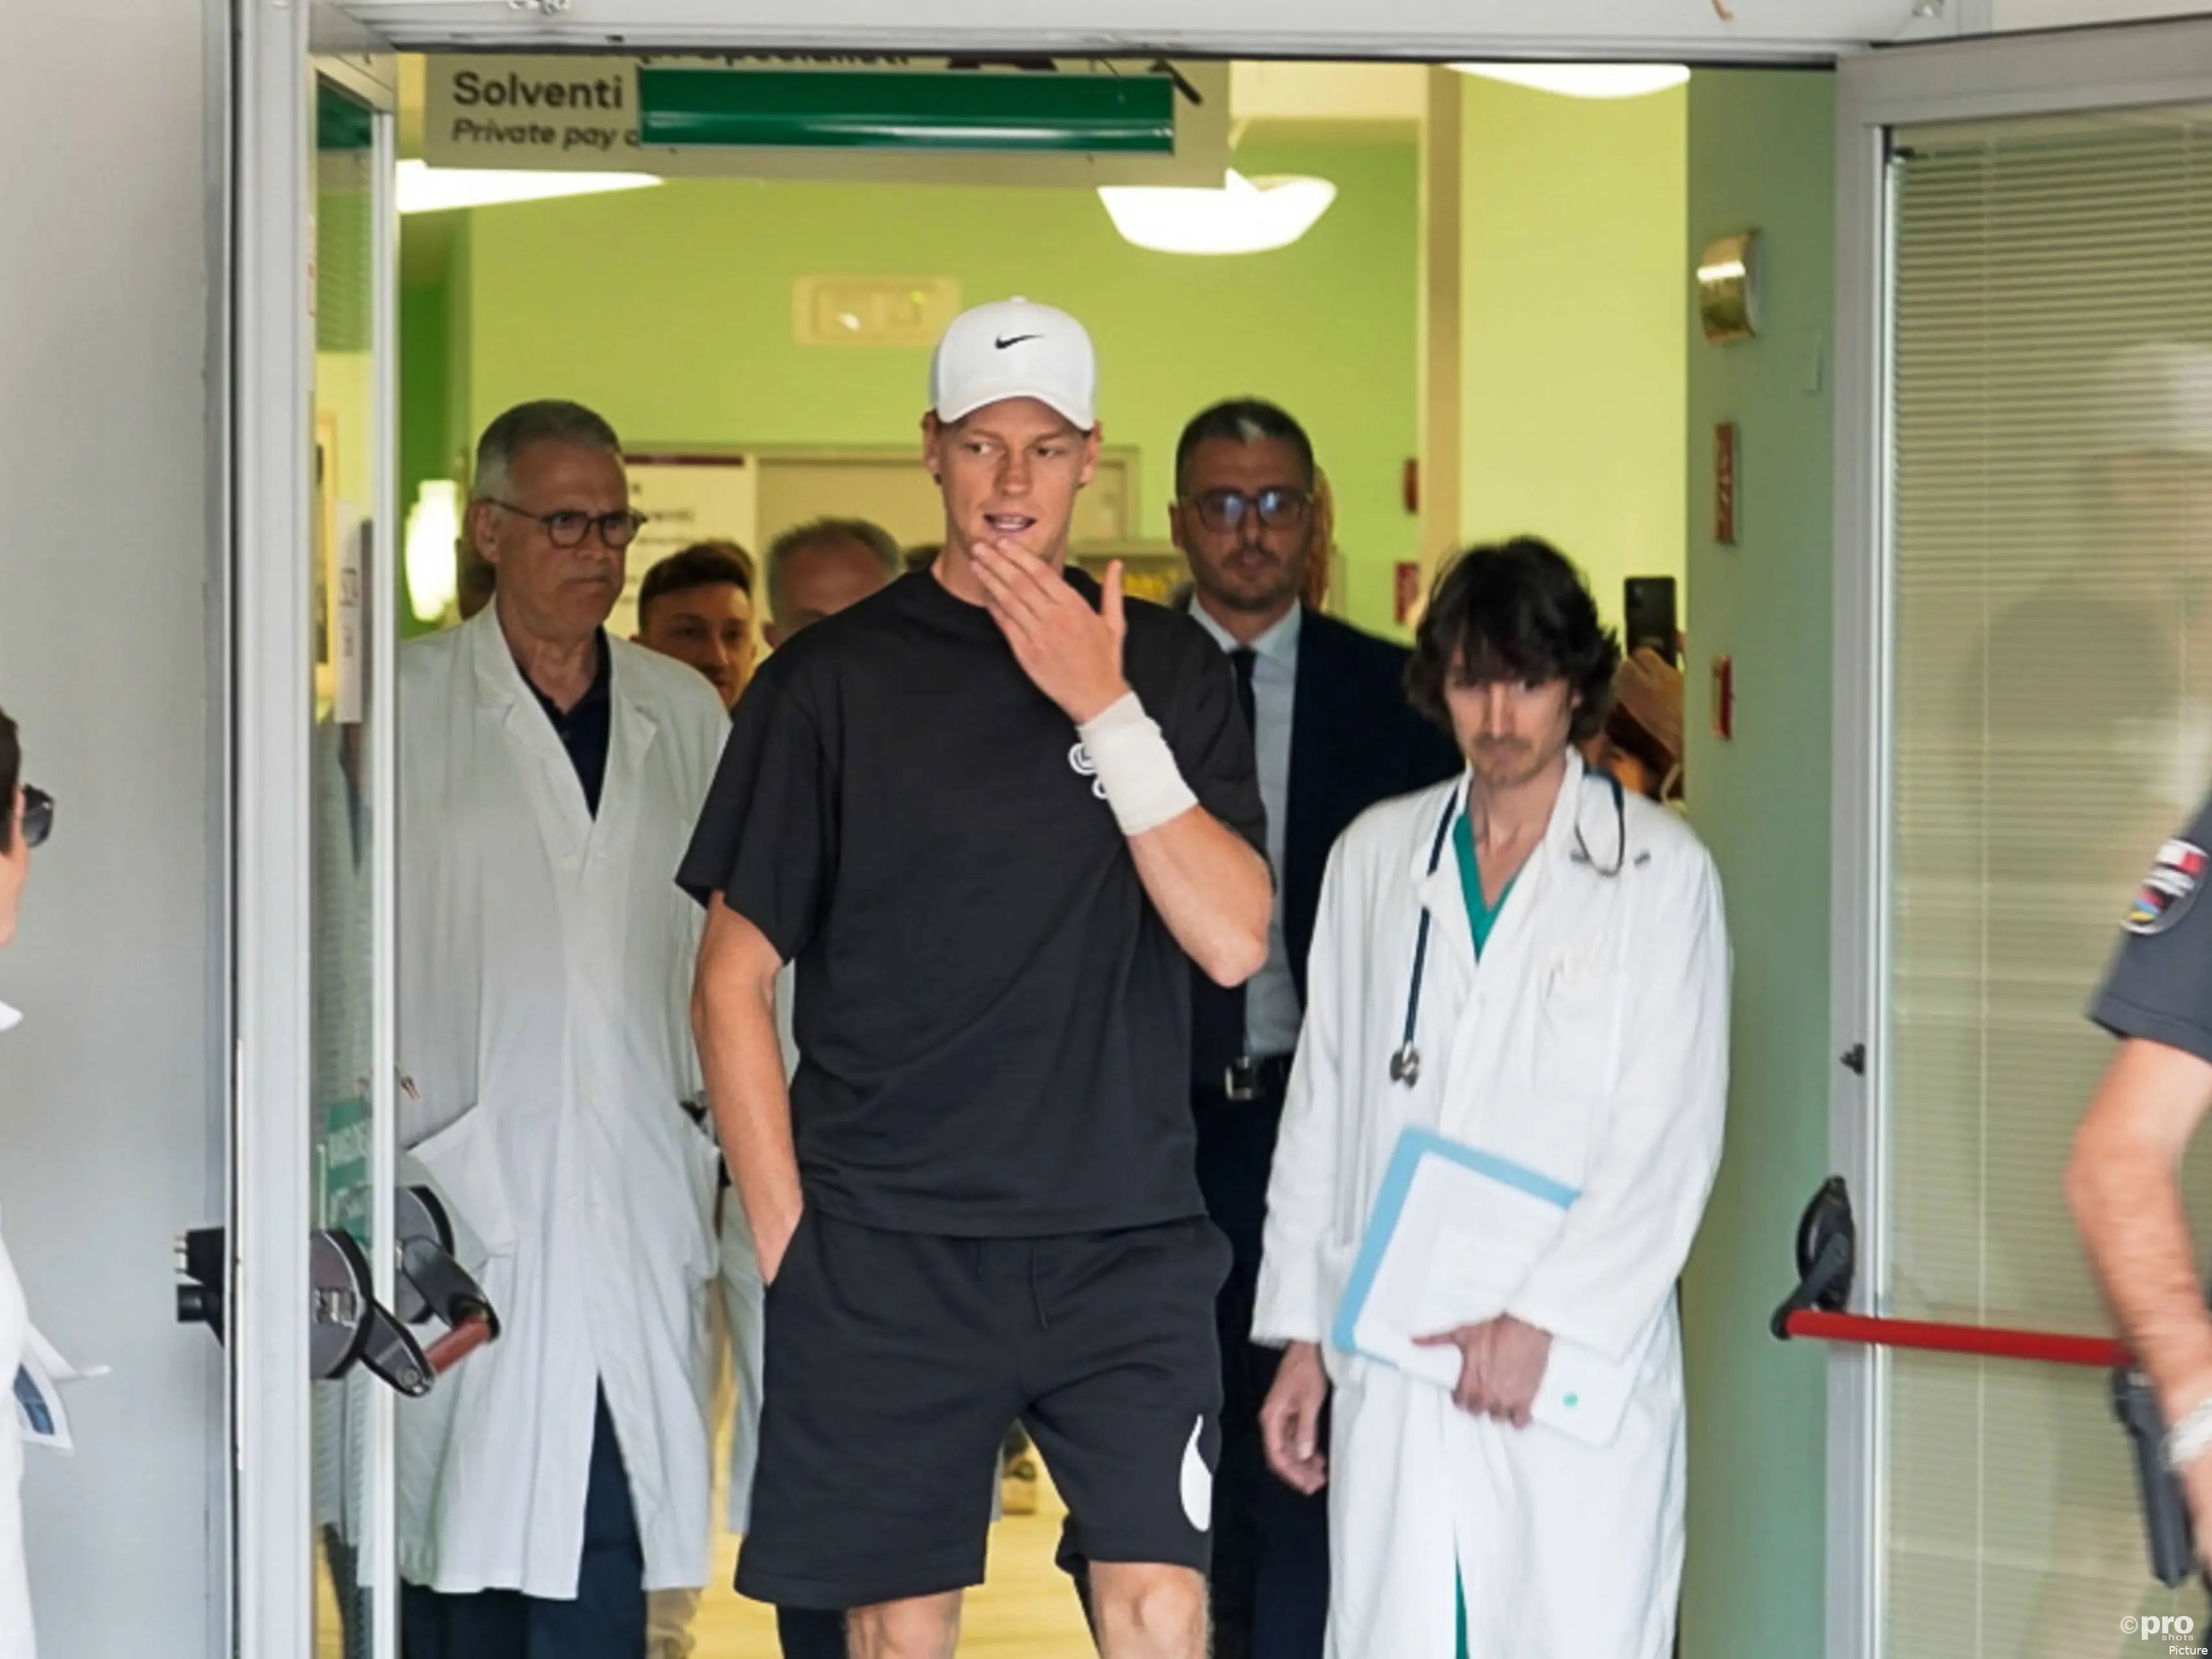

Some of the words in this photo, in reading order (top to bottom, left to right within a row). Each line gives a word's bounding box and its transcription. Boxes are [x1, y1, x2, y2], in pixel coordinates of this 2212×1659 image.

[452, 71, 623, 109] Solventi
[452, 117, 556, 145] Private
[561, 126, 618, 151] pay
